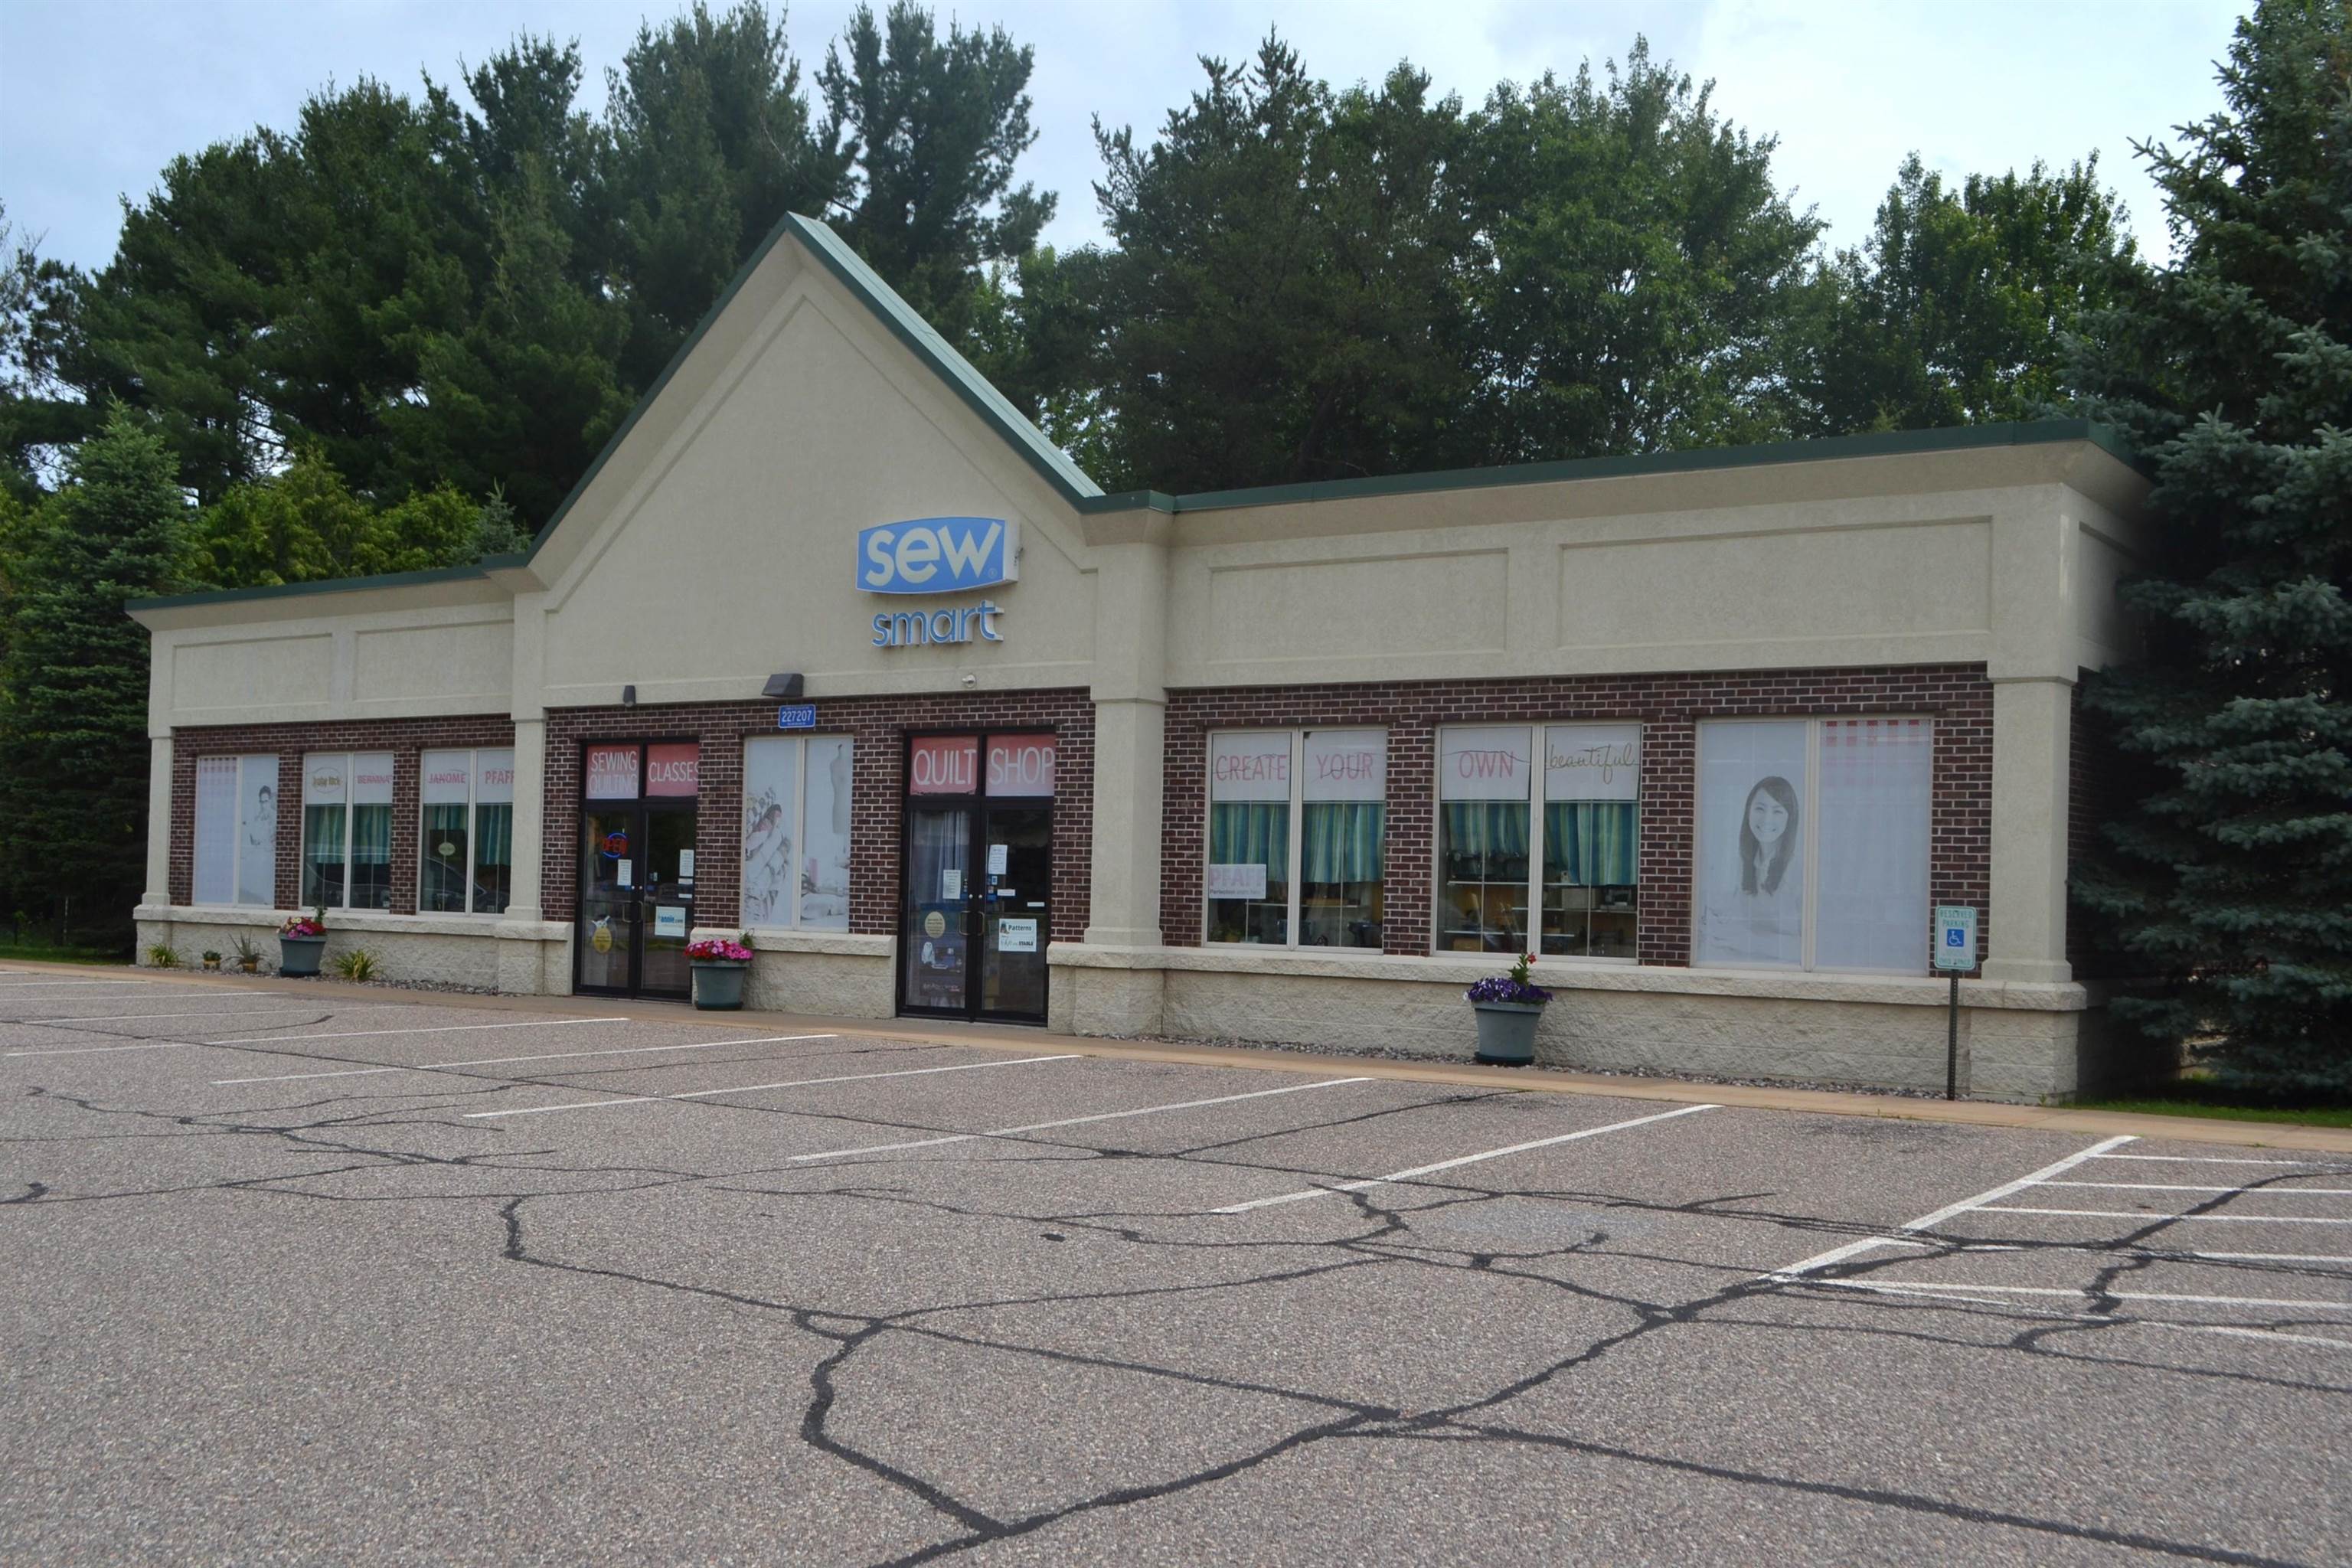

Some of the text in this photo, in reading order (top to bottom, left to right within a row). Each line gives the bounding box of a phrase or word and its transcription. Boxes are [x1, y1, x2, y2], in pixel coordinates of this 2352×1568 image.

[865, 521, 1002, 586] sew
[871, 599, 1003, 647] smart
[782, 710, 812, 723] 227207
[590, 751, 637, 773] SEWING
[913, 746, 1055, 786] QUILT SHOP
[1216, 743, 1635, 785] CREATE YOUR OWN beautiful
[427, 772, 466, 785] JANOME
[589, 773, 638, 795] QUILTING
[1939, 910, 1973, 919] RESERVED
[1942, 920, 1970, 929] PARKING
